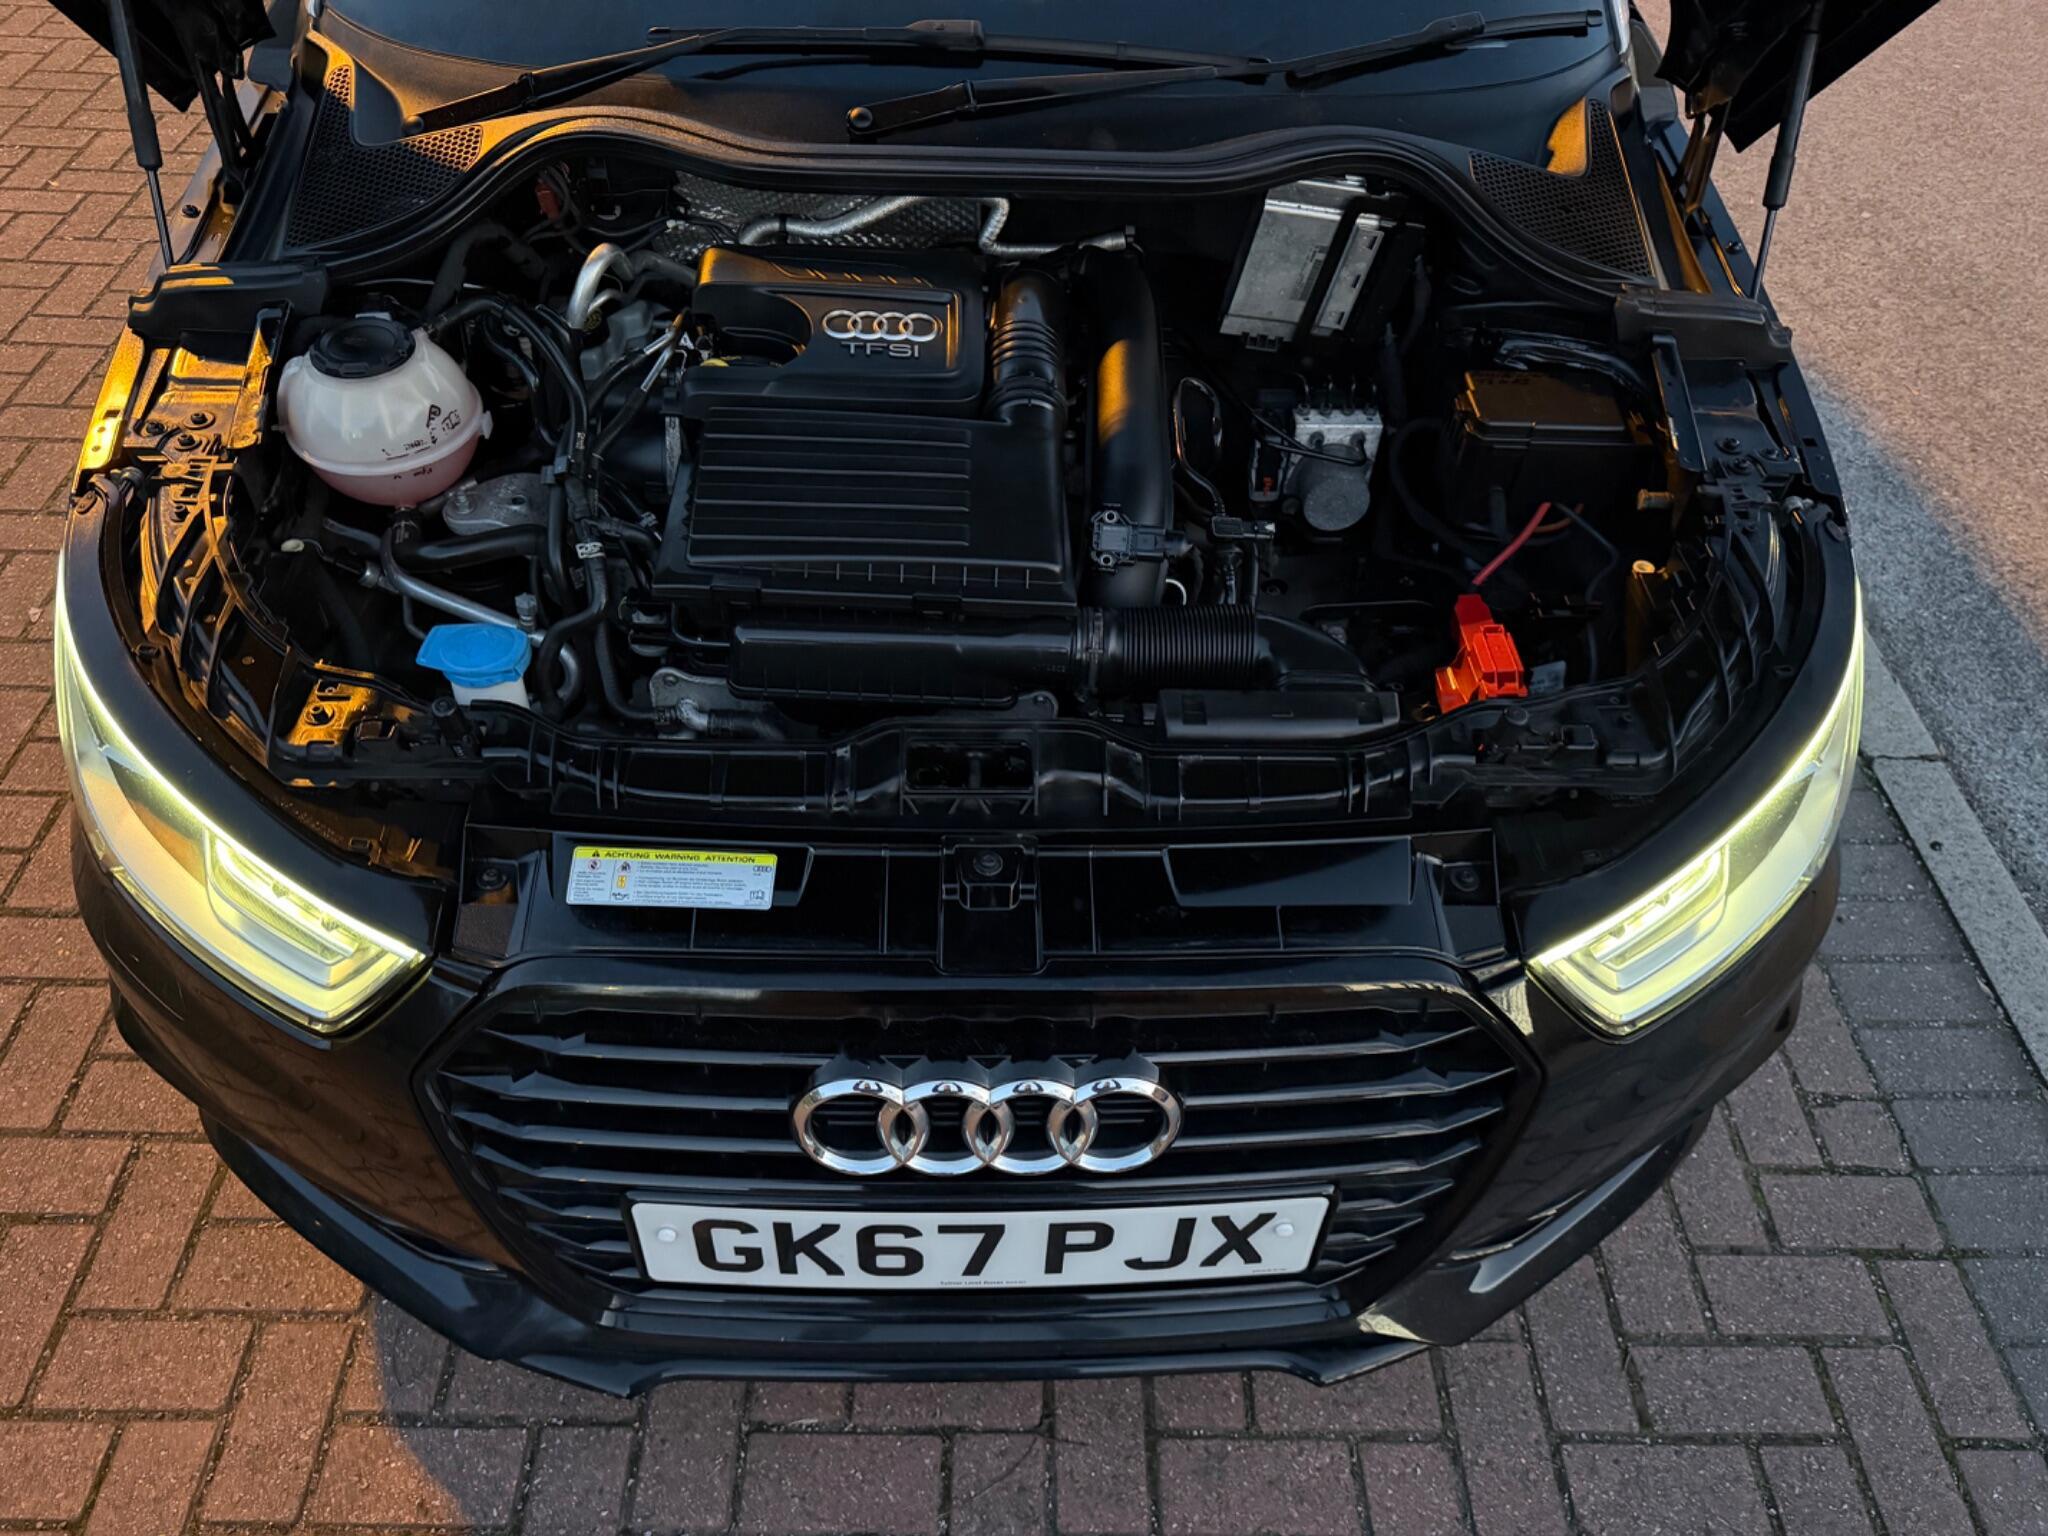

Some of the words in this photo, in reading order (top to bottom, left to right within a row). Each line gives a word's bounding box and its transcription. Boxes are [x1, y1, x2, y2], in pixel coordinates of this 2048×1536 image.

[840, 341, 920, 358] TFSI
[605, 851, 650, 860] ACHTUNG
[655, 853, 700, 862] WARNING
[704, 854, 756, 864] ATTENTION
[692, 1219, 1006, 1277] GK67
[1044, 1212, 1277, 1275] PJX
